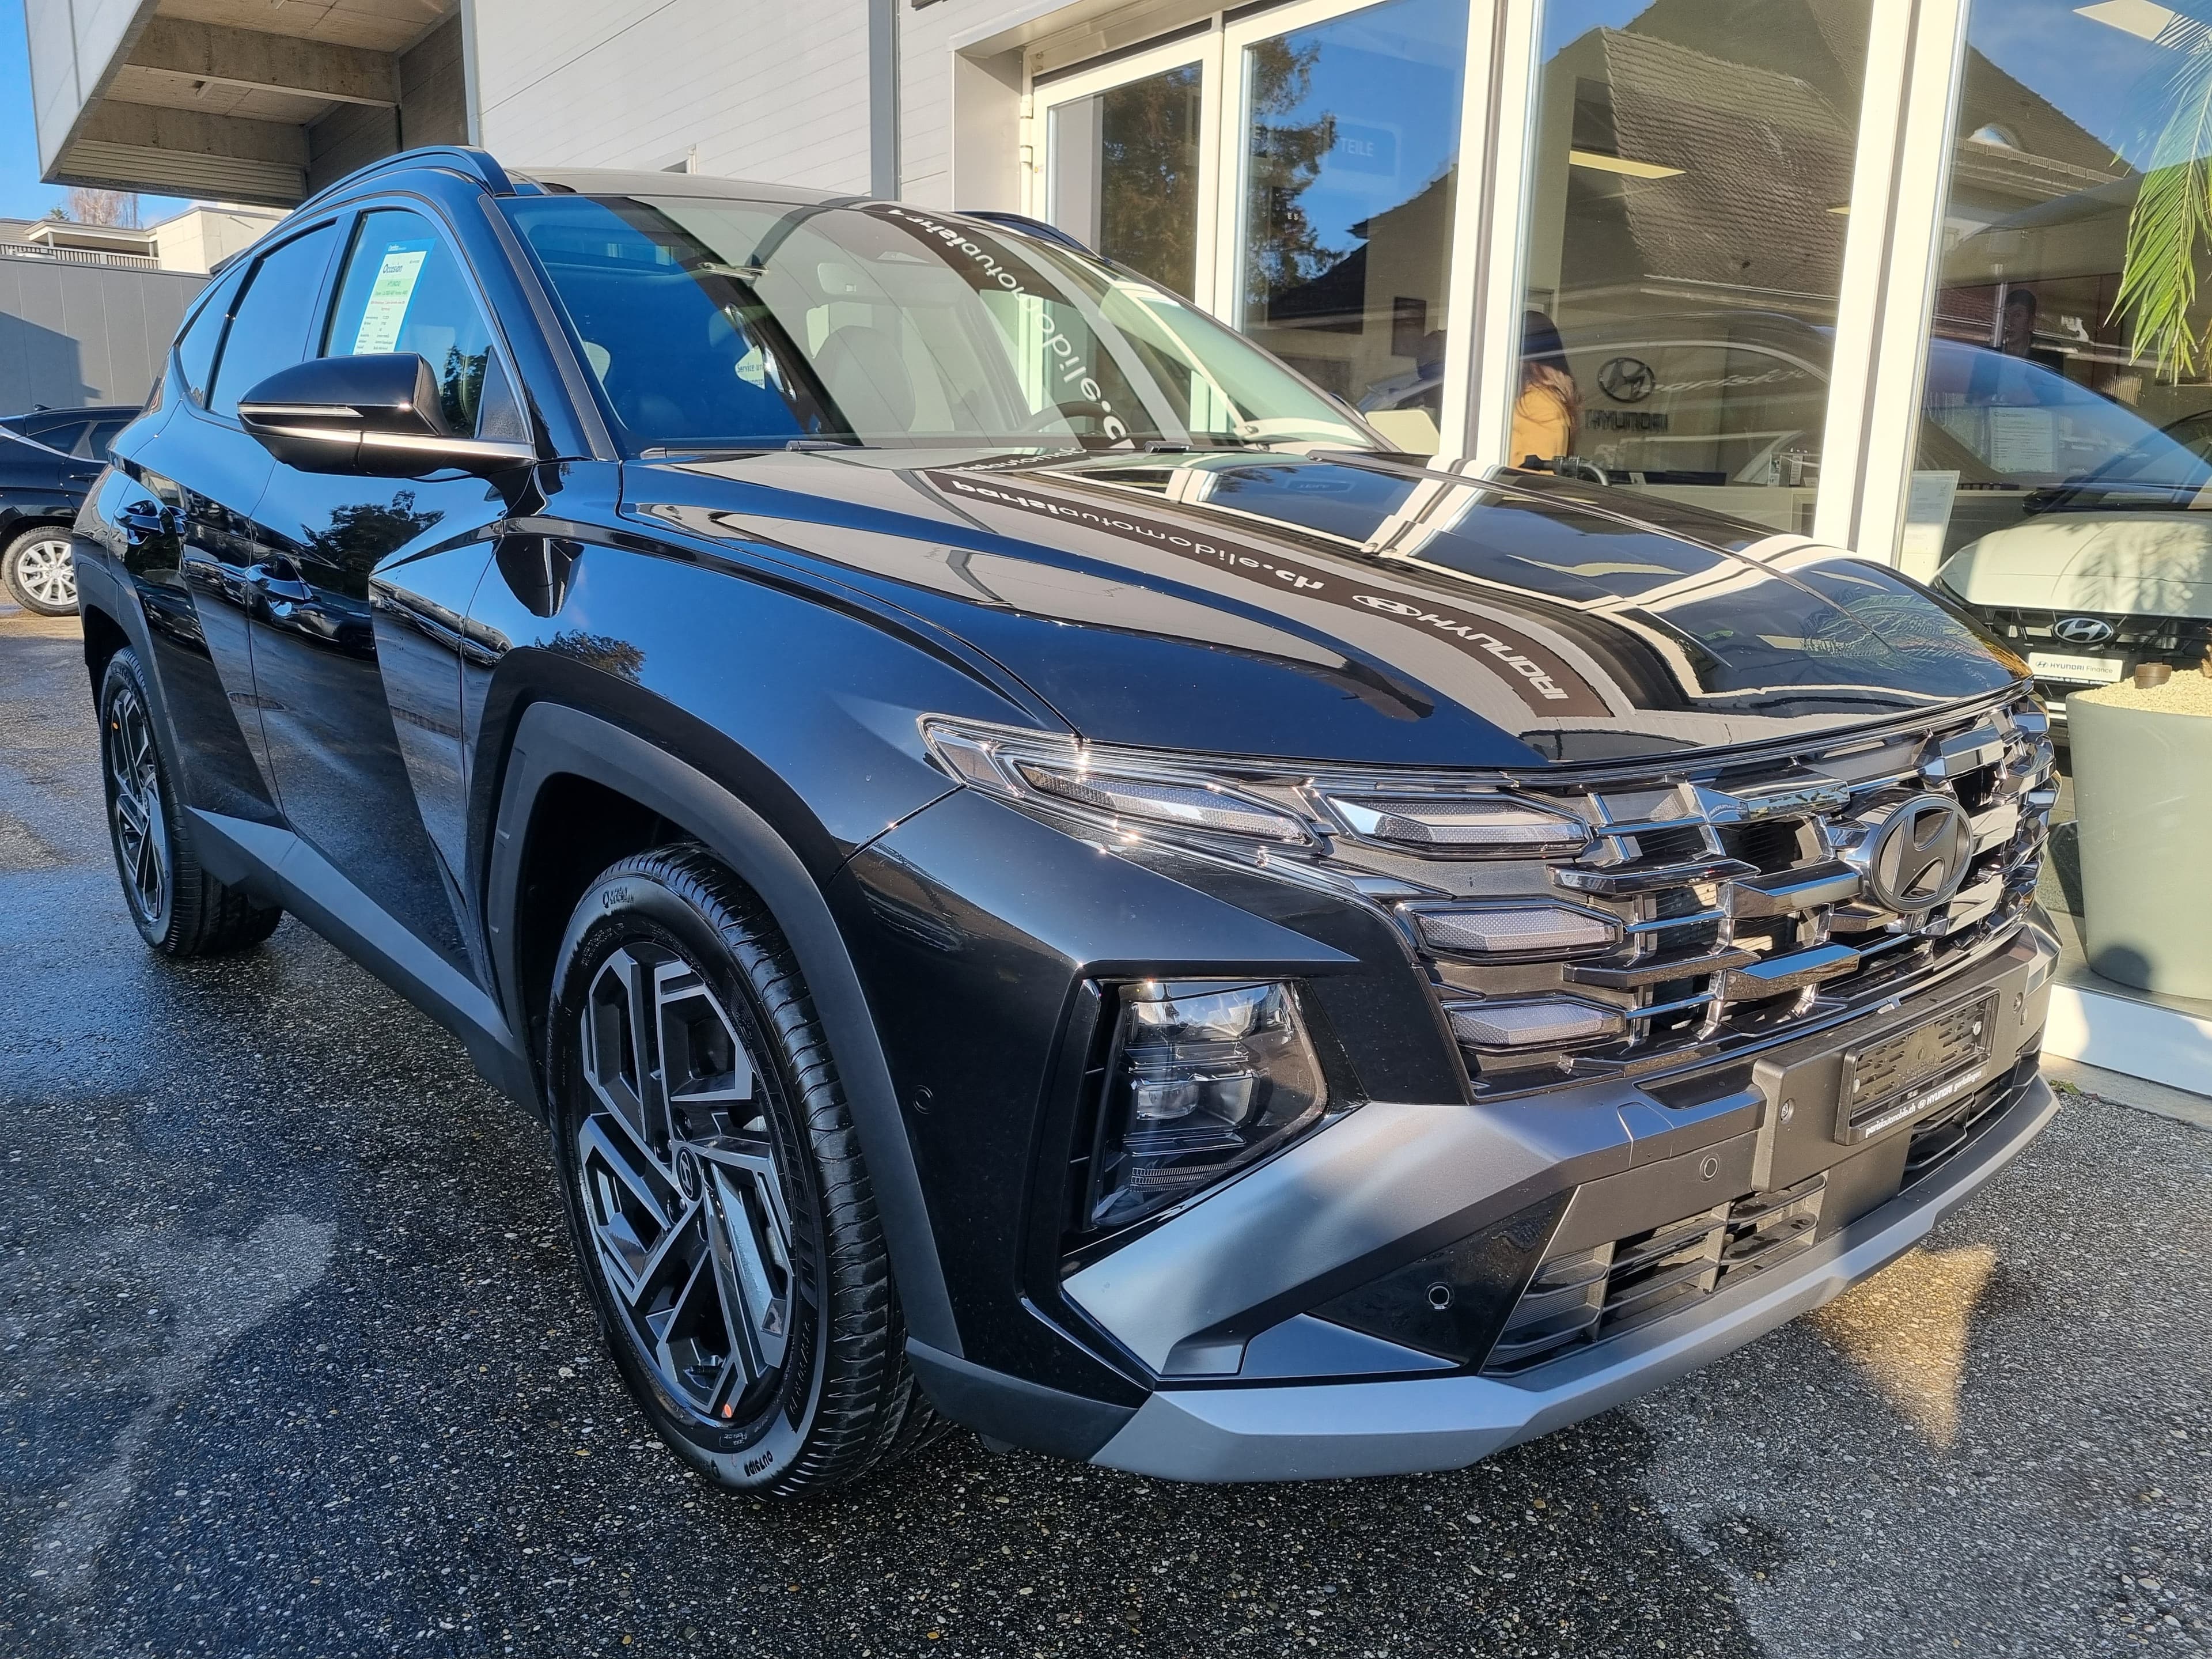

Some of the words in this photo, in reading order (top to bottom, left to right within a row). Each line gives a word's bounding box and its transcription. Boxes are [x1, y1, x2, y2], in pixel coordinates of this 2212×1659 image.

[1339, 138, 1374, 157] TEILE
[737, 362, 755, 373] Service
[2050, 662, 2084, 671] HYUNDAI
[2086, 665, 2113, 673] Finance
[1865, 1102, 1916, 1138] parisiautomobile.ch
[1926, 1084, 1953, 1105] HYUNDAI
[1953, 1070, 1982, 1093] gerlafingen
